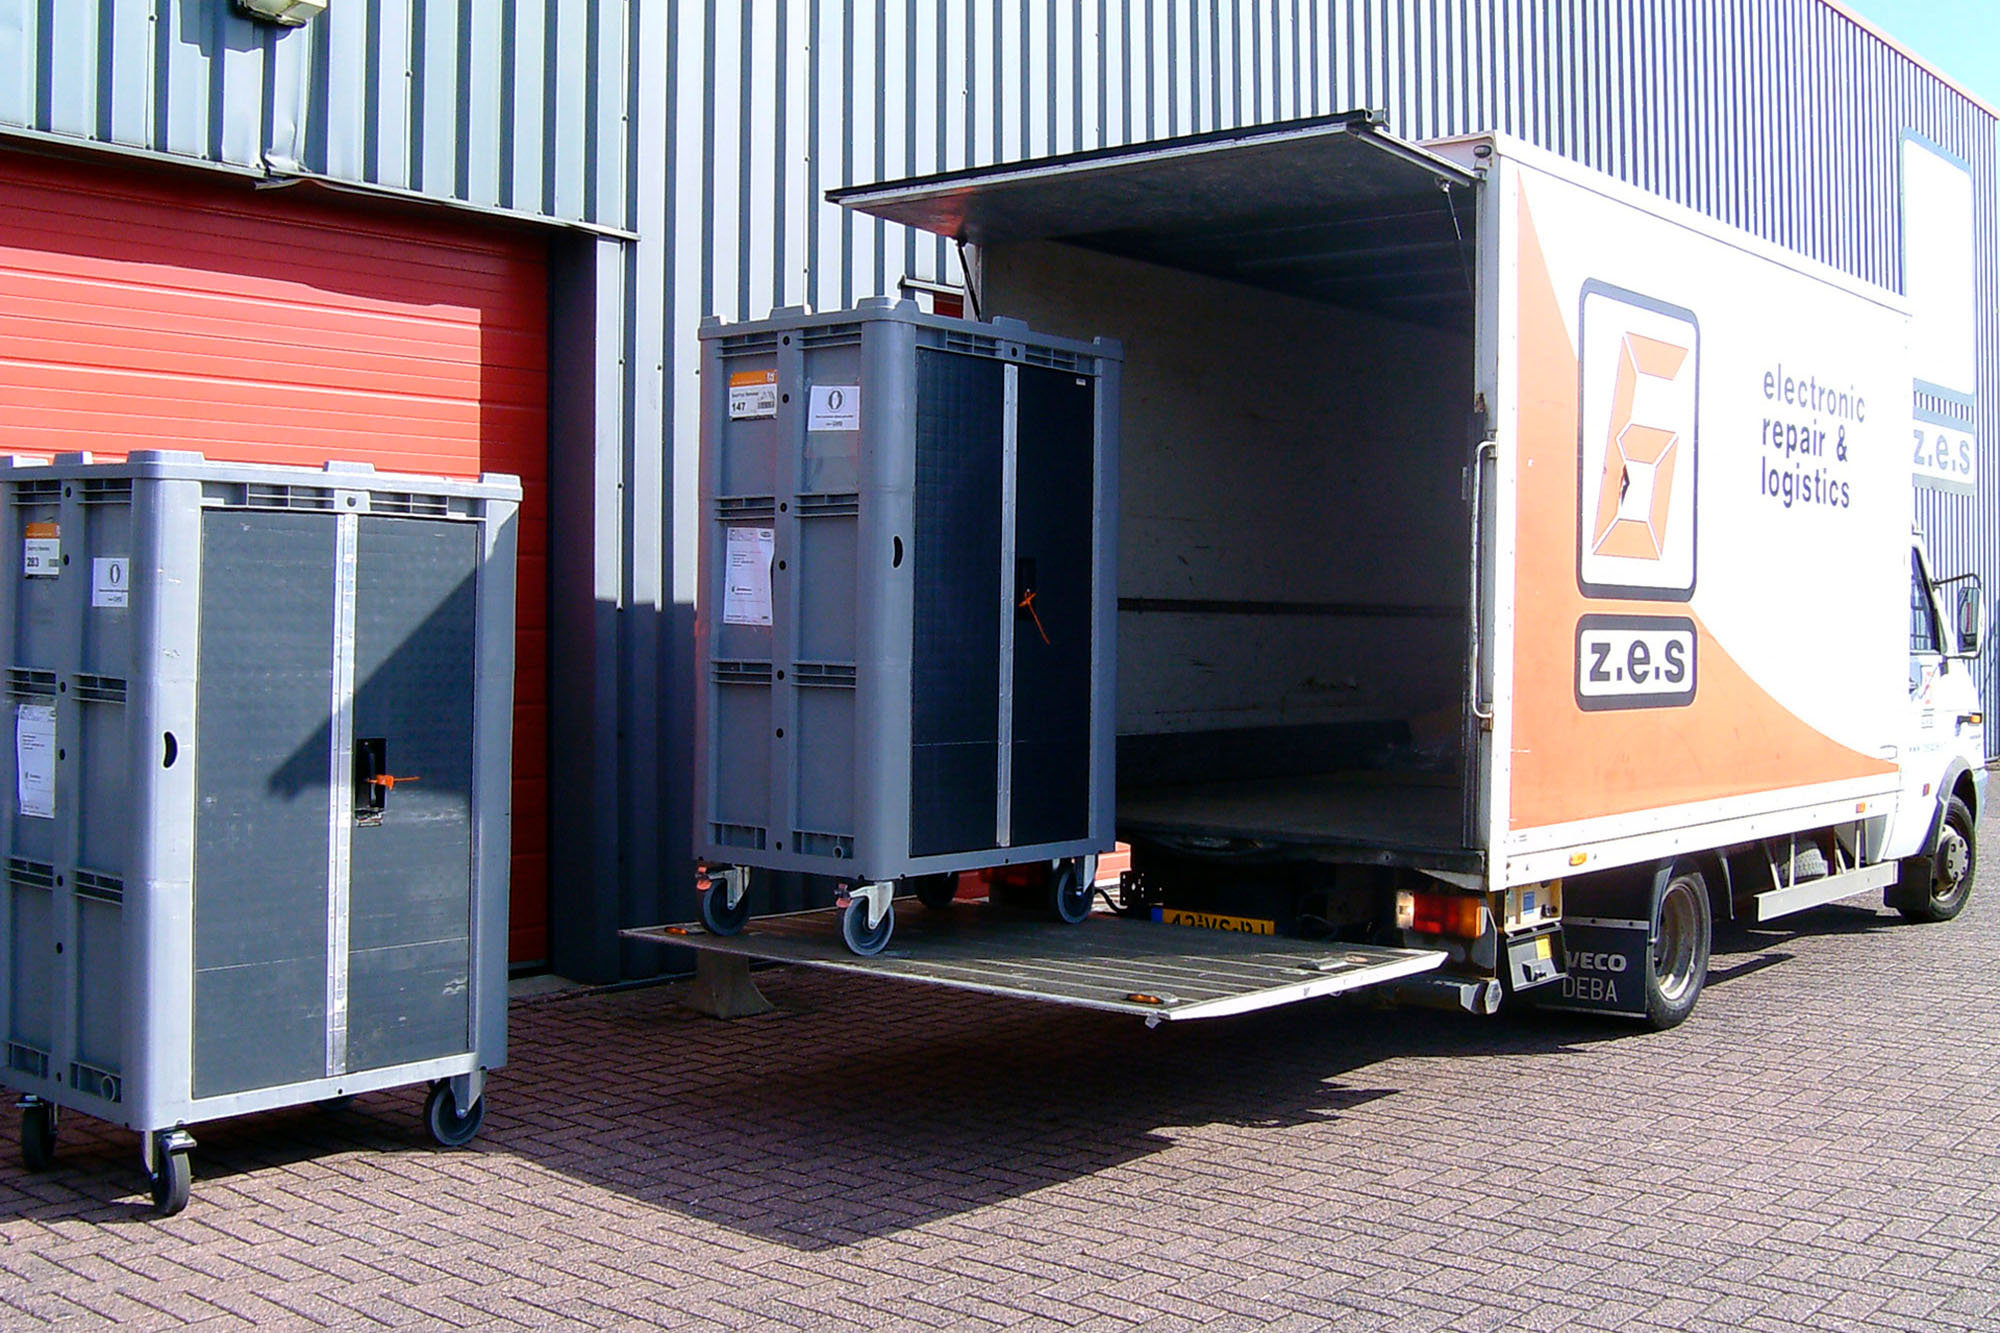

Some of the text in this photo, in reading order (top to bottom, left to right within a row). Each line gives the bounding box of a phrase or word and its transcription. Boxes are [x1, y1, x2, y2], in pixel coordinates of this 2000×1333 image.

[732, 402, 746, 411] 147
[1763, 363, 1866, 423] electronic
[1762, 418, 1848, 462] repair &
[1913, 429, 1970, 475] z.e.s
[1761, 456, 1850, 508] logistics
[1589, 639, 1685, 684] z.e.s
[1565, 951, 1627, 972] VECO
[1563, 976, 1618, 1002] DEBA
